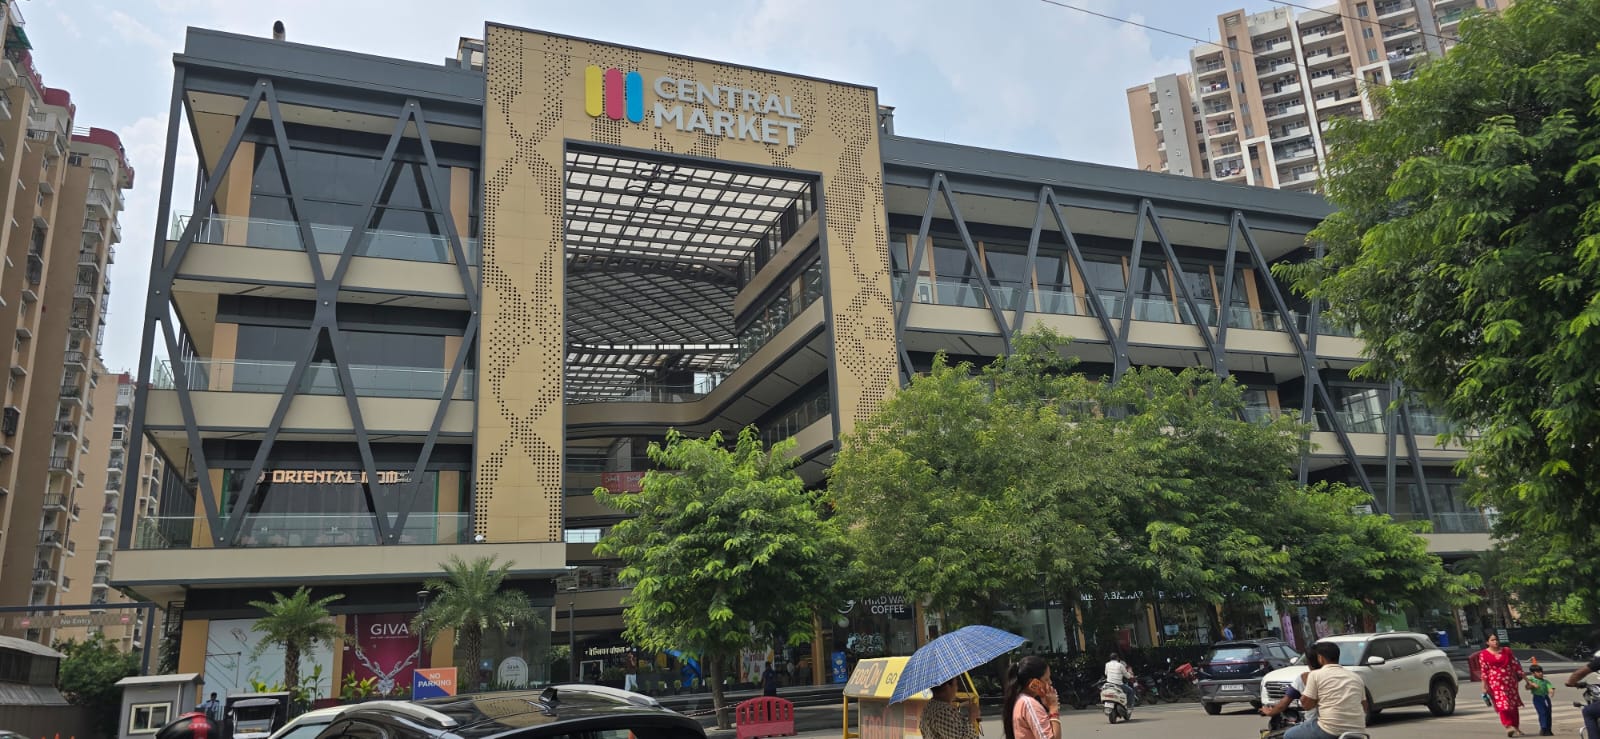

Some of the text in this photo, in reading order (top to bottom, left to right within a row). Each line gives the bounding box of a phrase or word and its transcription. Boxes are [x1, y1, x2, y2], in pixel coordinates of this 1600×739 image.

[653, 76, 800, 118] CENTRAL
[653, 102, 800, 148] MARKET
[272, 469, 356, 484] ORIENTAL
[871, 604, 905, 614] COFFEE
[72, 617, 91, 626] Entry
[370, 623, 409, 635] GIVA
[417, 679, 452, 688] PARKING
